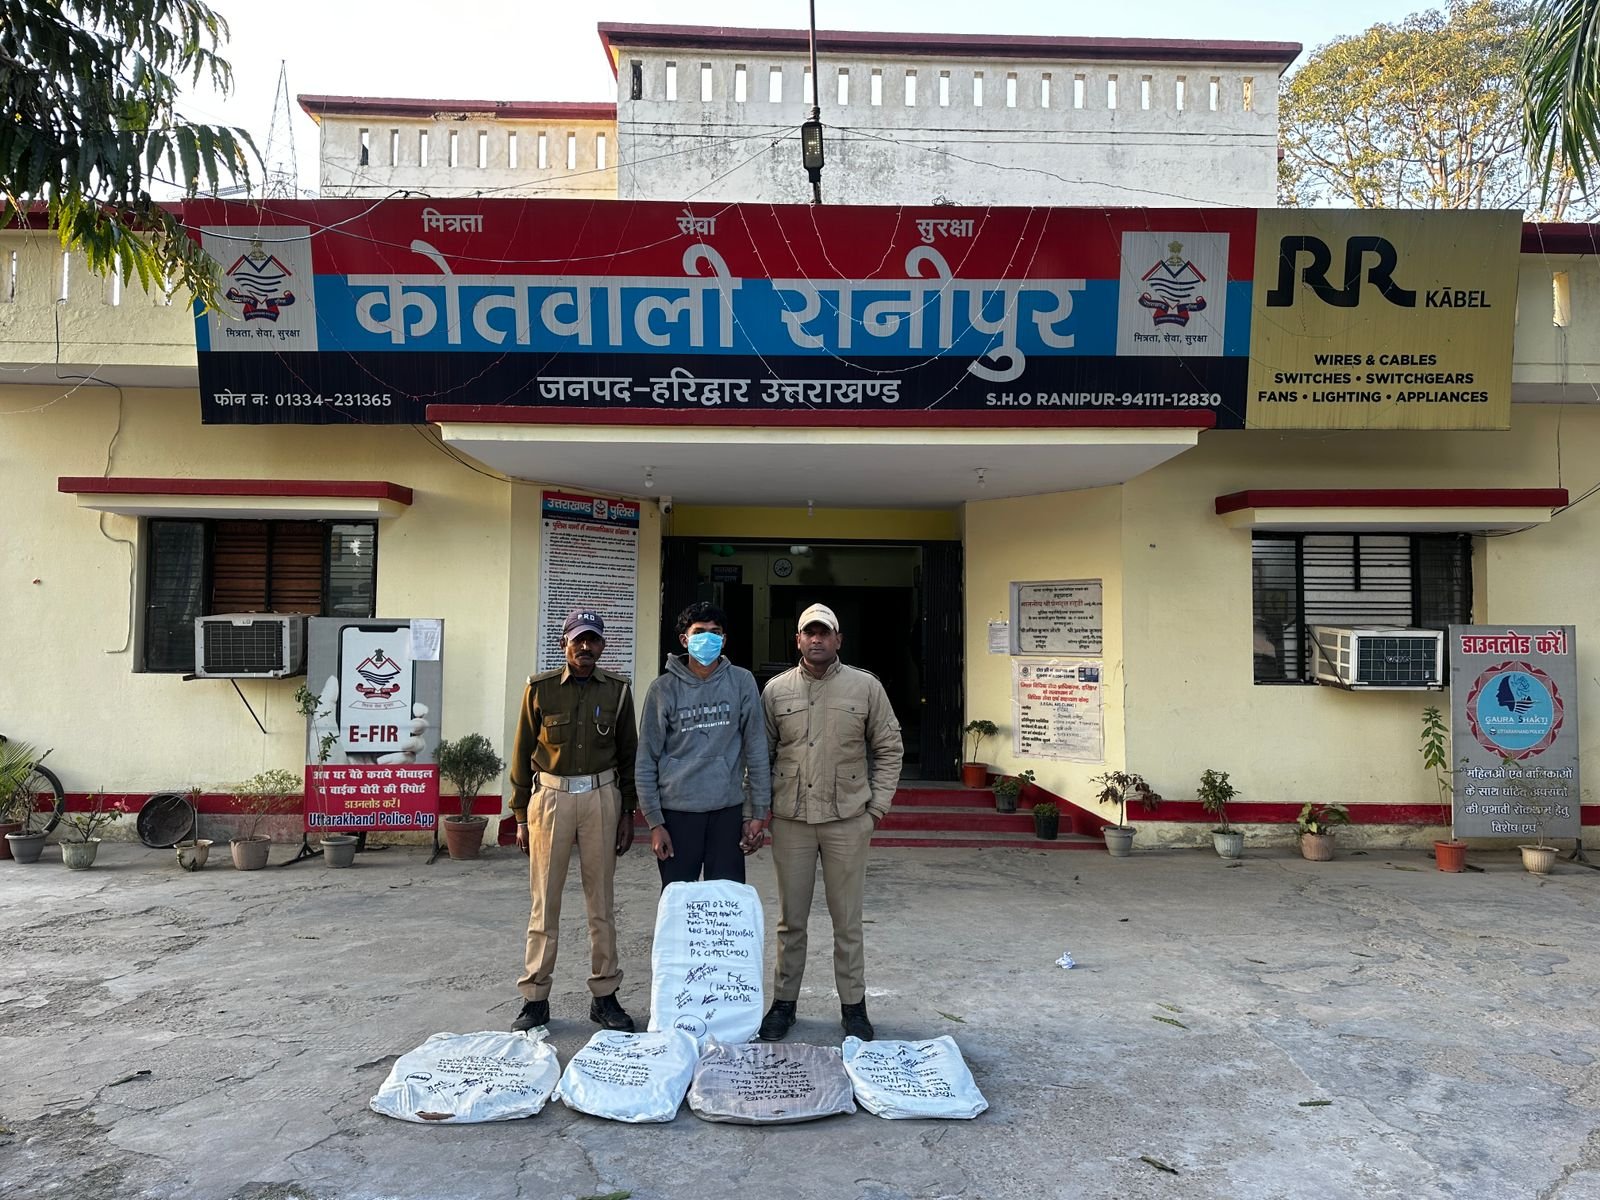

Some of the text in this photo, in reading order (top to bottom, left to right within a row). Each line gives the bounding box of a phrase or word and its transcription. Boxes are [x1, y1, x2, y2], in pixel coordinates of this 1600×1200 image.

[422, 208, 483, 233] मित्रता
[676, 210, 717, 236] सेवा
[916, 217, 975, 243] सुरक्षा
[1267, 235, 1417, 308] RR
[347, 239, 1086, 383] कोतवाली रानीपुर
[226, 327, 254, 338] मित्रता,
[278, 328, 300, 340] सुरक्षा
[1134, 332, 1161, 343] मित्रता,
[1185, 334, 1208, 345] सुरक्षा
[1314, 354, 1437, 366] WIRES & CABLES
[1274, 373, 1474, 385] SWITCHES SWITCHGEARS
[760, 378, 902, 404] उत्तराखण्ड
[1258, 391, 1489, 403] FANS LIGHTING APPLIANCES
[214, 389, 246, 408] फोन
[275, 392, 392, 408] 01334-231365
[985, 393, 1031, 407] S.H.O
[547, 497, 635, 520] उत्तराखण्ड पुलिस
[1460, 630, 1531, 655] डाउनलोड
[1485, 715, 1548, 724] GAURA SHAKTI
[349, 725, 398, 742] E-FIR
[333, 770, 346, 779] घर
[396, 768, 433, 779] मोबाइल
[360, 784, 380, 794] चोरी
[383, 784, 396, 794] की
[400, 783, 426, 794] रिपोर्ट
[1465, 785, 1476, 796] के
[1478, 787, 1499, 796] साथ
[345, 798, 380, 809] डाउनलोड
[1465, 803, 1478, 814] की
[1482, 803, 1510, 816] प्रभावी
[309, 811, 435, 827] Uttarakhand Police App
[1491, 821, 1518, 833] विशेष
